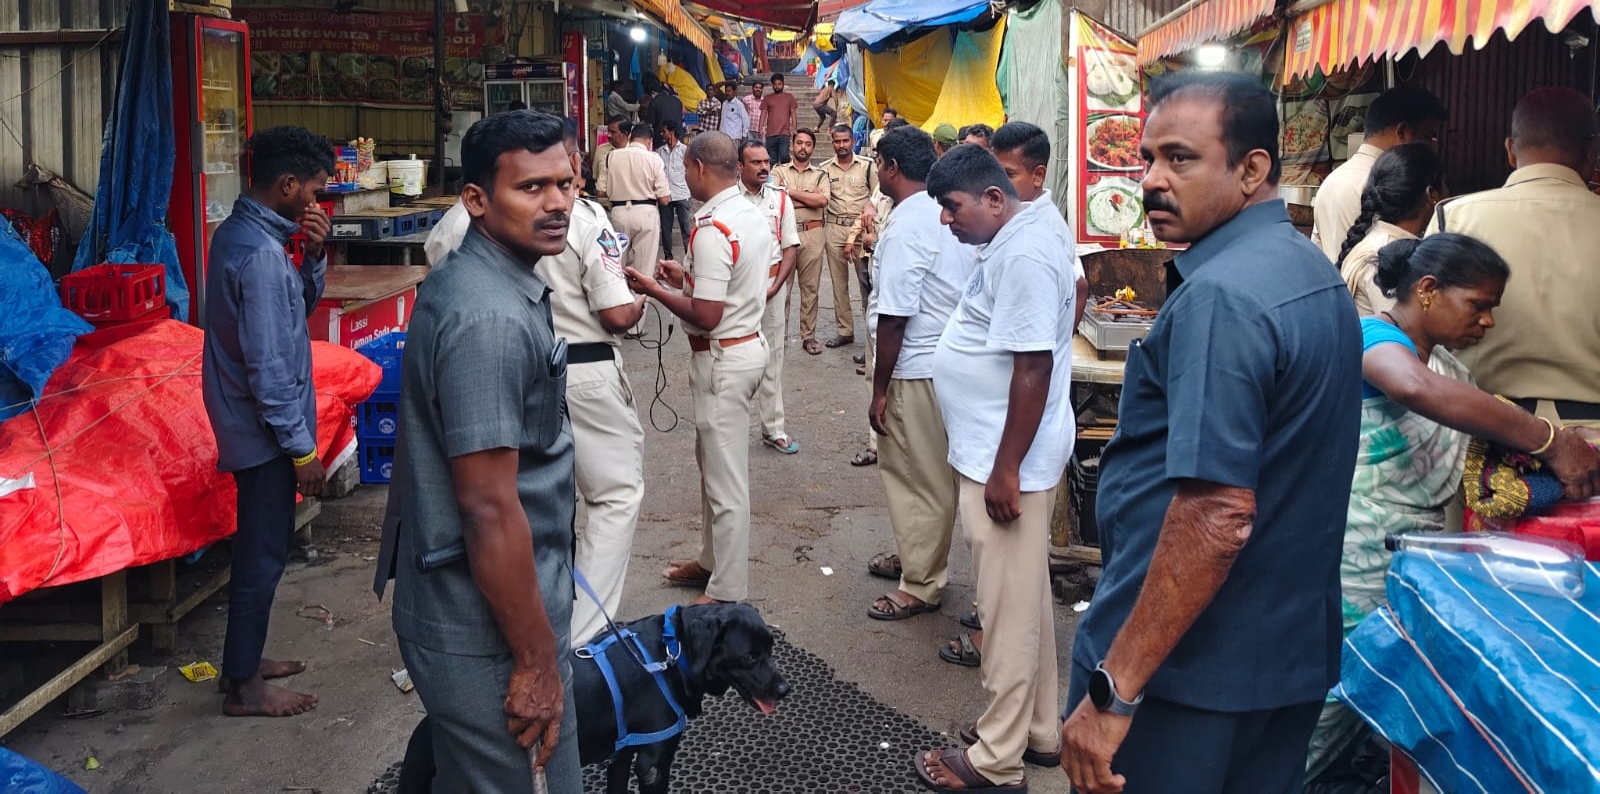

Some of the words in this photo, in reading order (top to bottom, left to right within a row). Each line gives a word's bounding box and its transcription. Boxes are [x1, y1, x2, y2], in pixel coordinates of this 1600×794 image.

[377, 30, 421, 42] Fast
[350, 315, 368, 332] Lassi
[350, 334, 373, 350] Lemon
[373, 324, 390, 340] Soda
